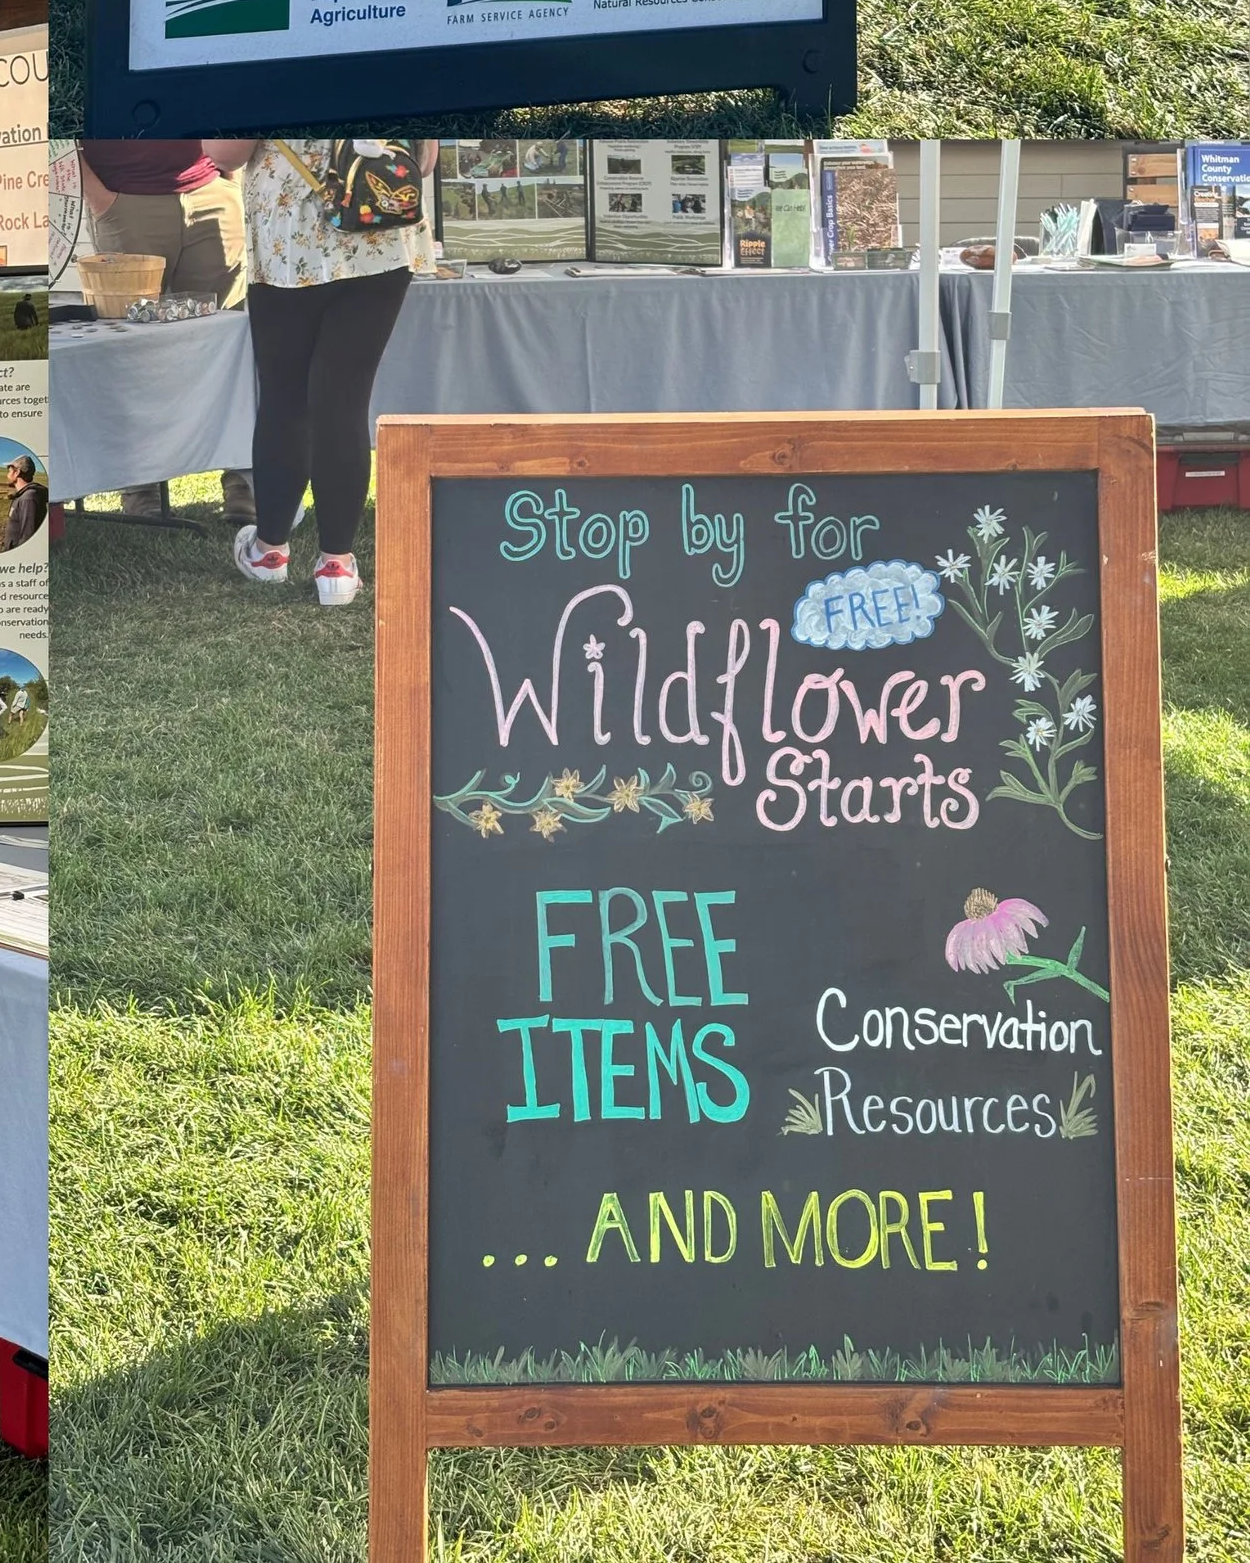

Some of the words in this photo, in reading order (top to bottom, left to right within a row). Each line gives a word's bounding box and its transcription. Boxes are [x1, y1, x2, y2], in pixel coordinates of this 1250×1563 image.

[310, 3, 406, 26] Agriculture
[447, 13, 475, 25] FARM
[481, 9, 523, 23] SERVICE
[528, 7, 569, 19] AGENCY
[1201, 154, 1240, 164] Whitman
[1201, 164, 1232, 174] County
[825, 195, 833, 218] Basics
[740, 240, 766, 249] Ripple
[16, 383, 31, 392] are
[500, 488, 650, 579] Stop
[681, 482, 746, 587] by
[774, 482, 880, 561] for
[0, 566, 15, 574] we
[824, 584, 921, 633] FREE!
[448, 584, 987, 787] Wildflower
[755, 747, 982, 831] Starts
[535, 886, 749, 1007] FREE
[815, 987, 1103, 1057] Conservation
[496, 1014, 750, 1124] ITEMS
[813, 1066, 1057, 1139] Resources
[585, 1189, 738, 1264] AND
